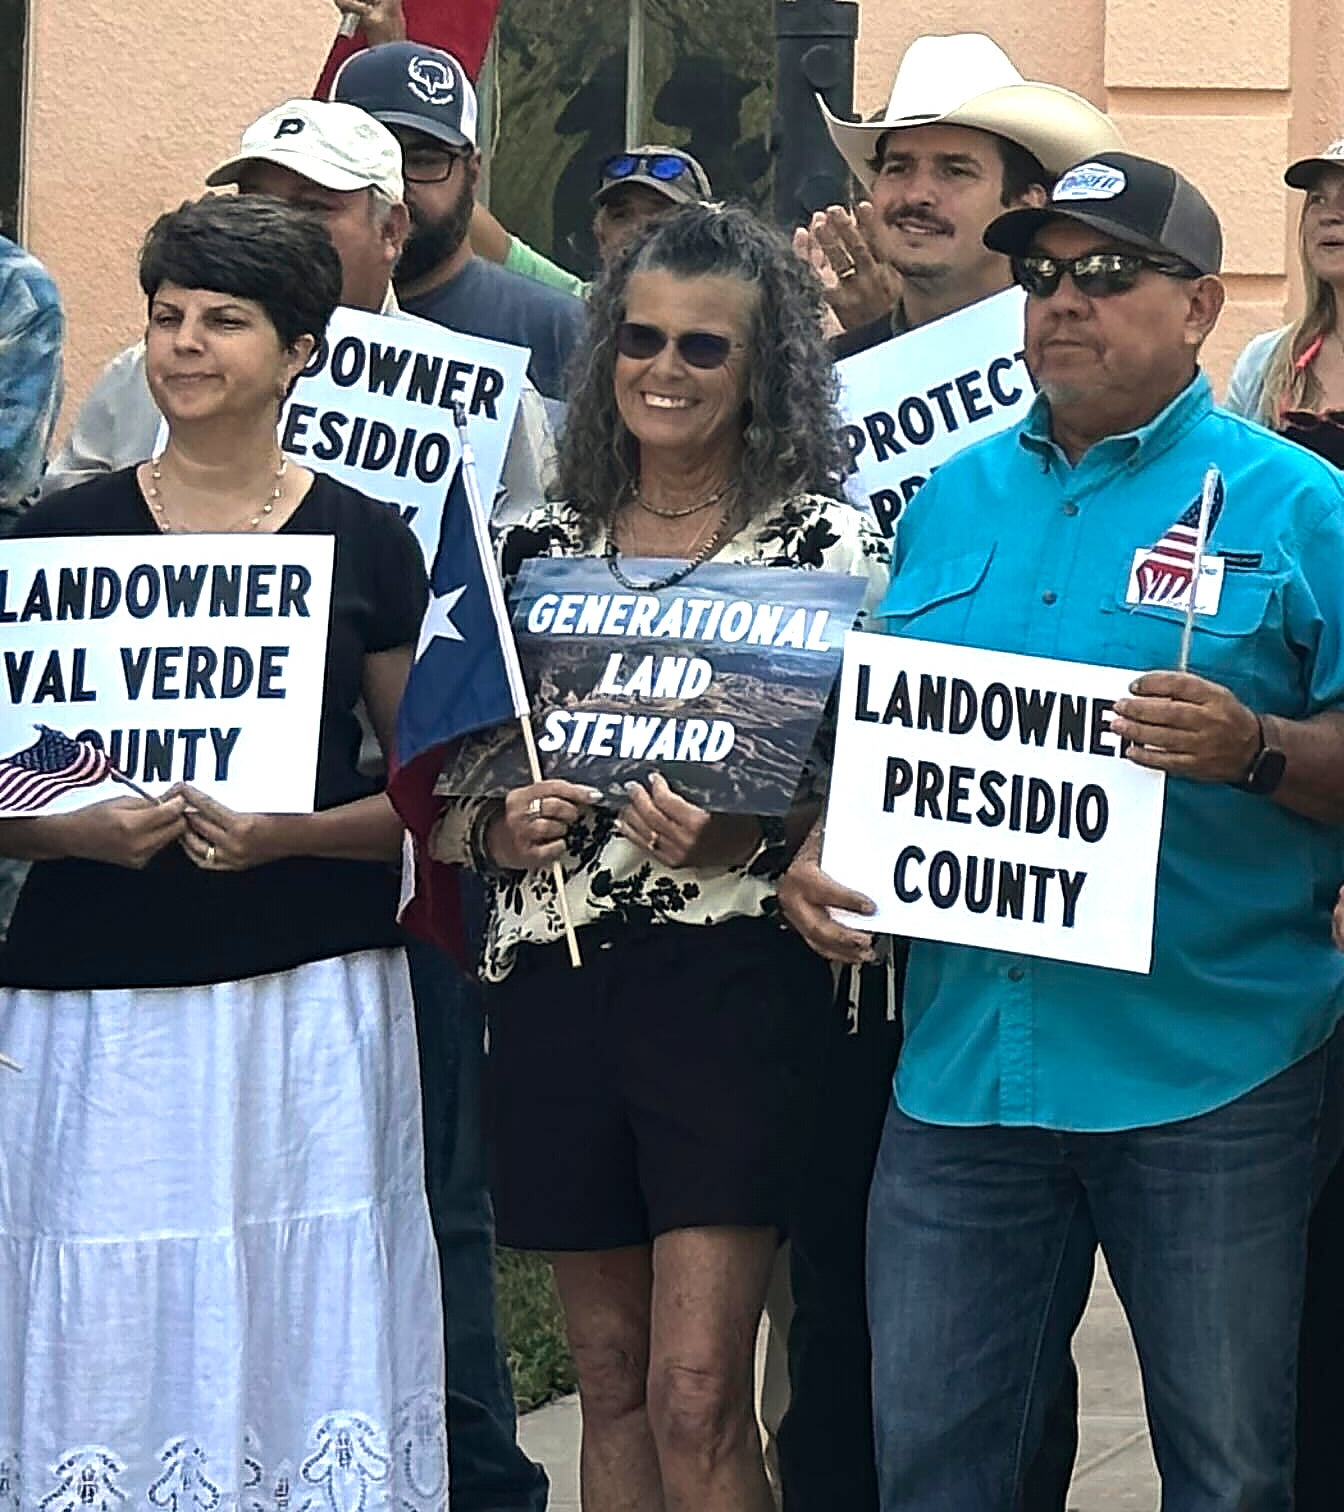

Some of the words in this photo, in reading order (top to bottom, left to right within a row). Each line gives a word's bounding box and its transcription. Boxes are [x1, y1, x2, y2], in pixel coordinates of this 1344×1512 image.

[273, 118, 306, 139] P
[0, 564, 312, 623] LANDOWNER
[528, 594, 832, 652] GENERATIONAL
[4, 648, 97, 704] VAL
[119, 645, 290, 700] VERDE
[600, 653, 713, 700] LAND
[538, 710, 736, 762] STEWARD
[855, 664, 1131, 758] LANDOWNE
[883, 756, 1109, 844] PRESIDIO
[894, 846, 1088, 928] COUNTY
